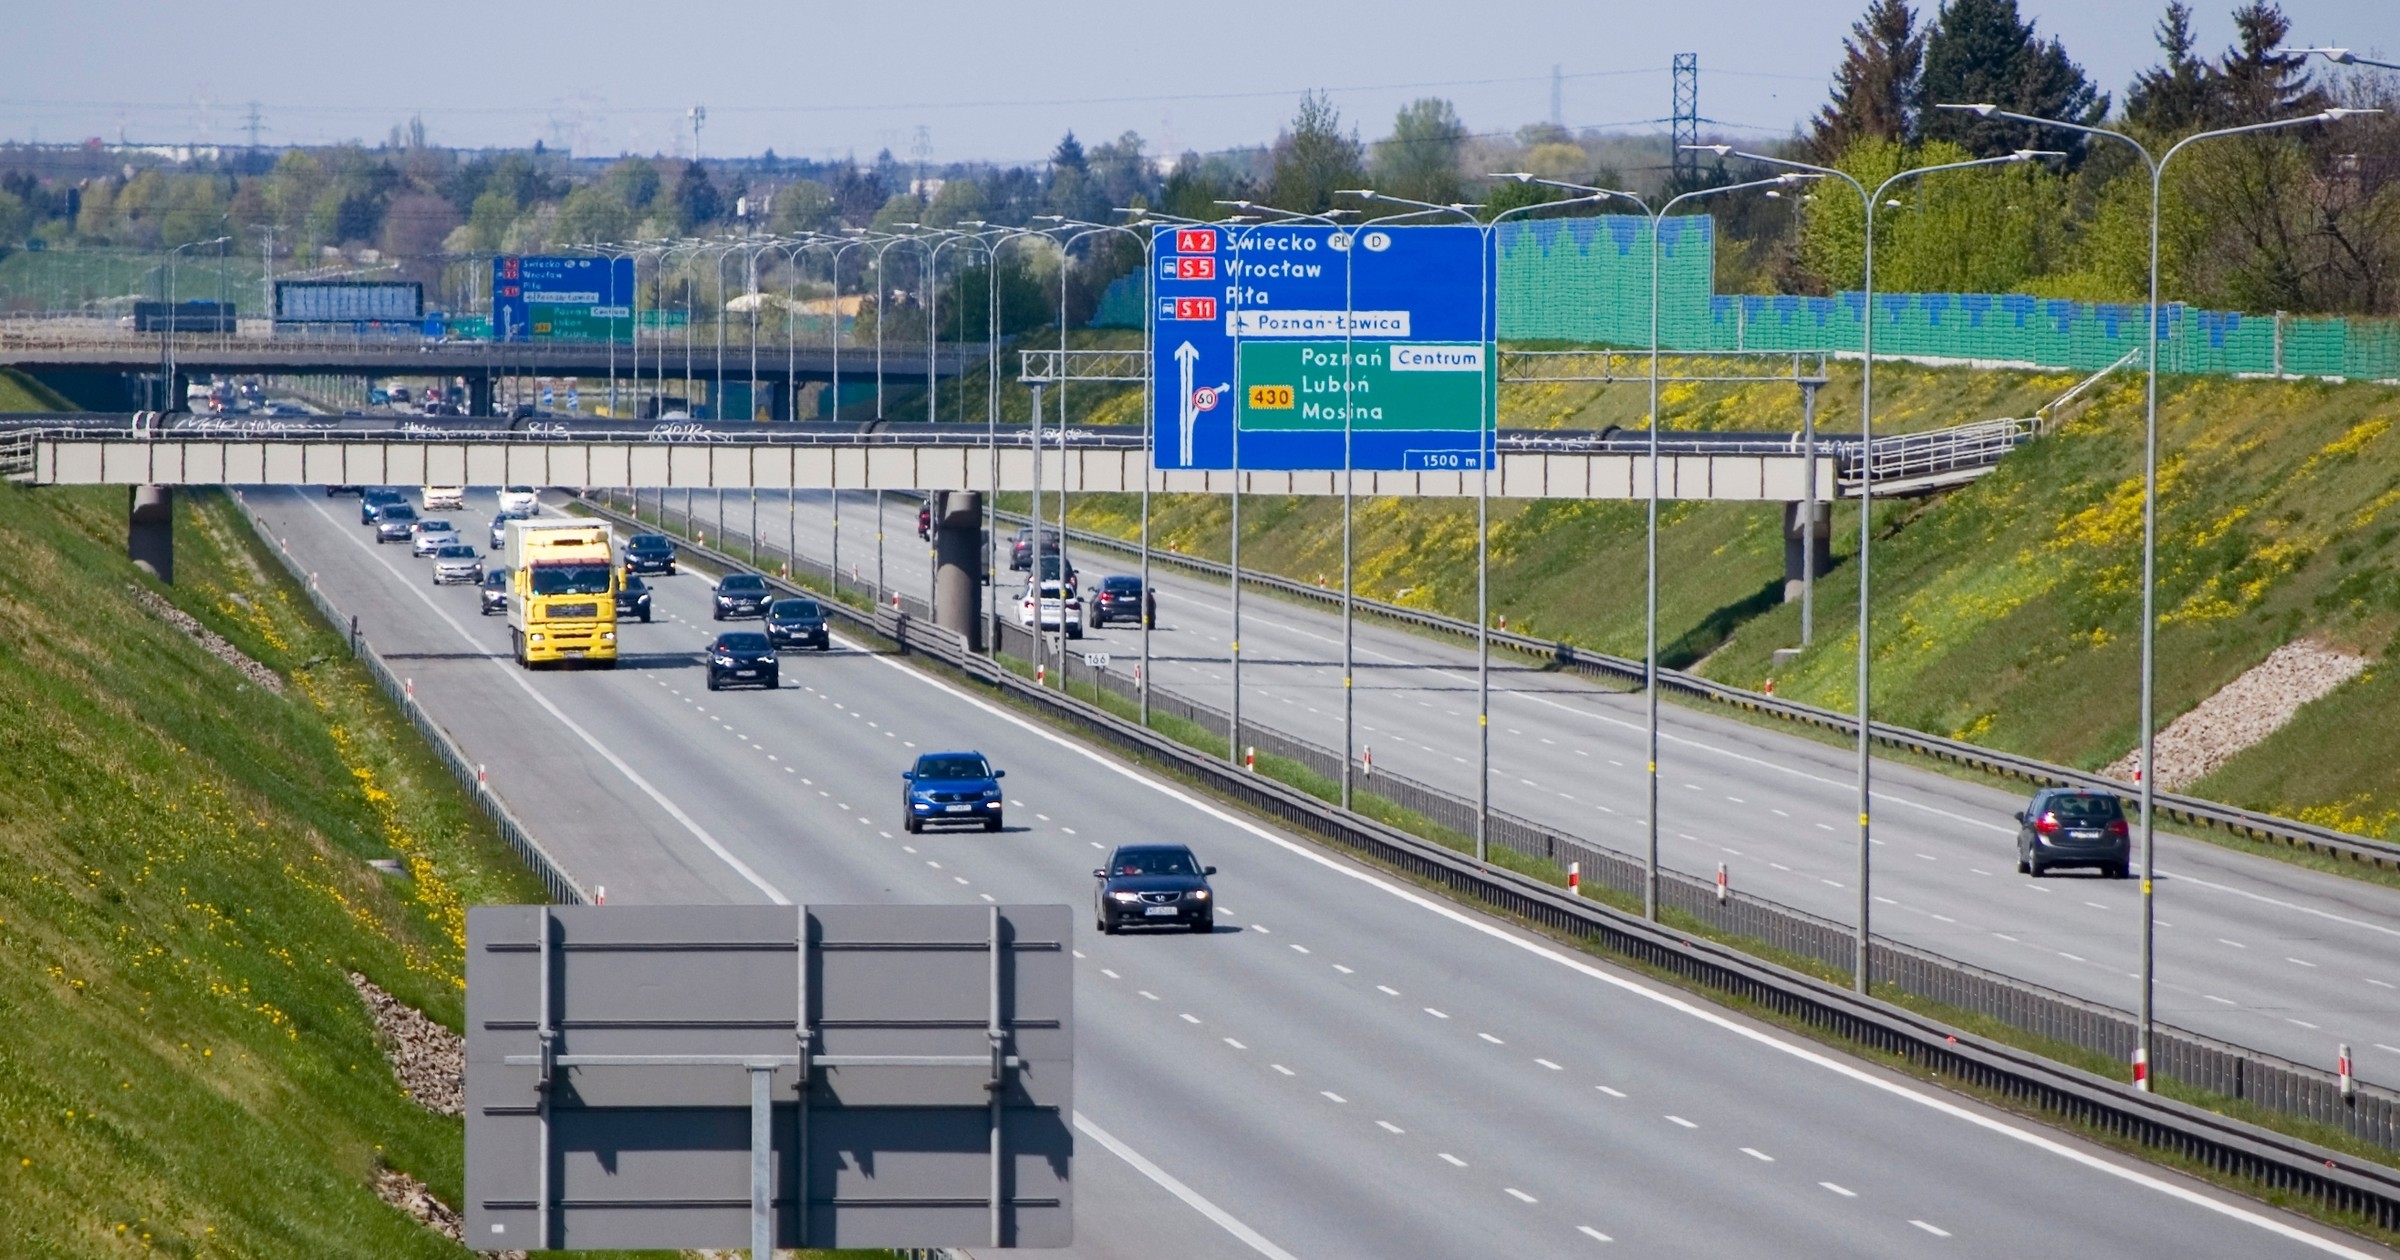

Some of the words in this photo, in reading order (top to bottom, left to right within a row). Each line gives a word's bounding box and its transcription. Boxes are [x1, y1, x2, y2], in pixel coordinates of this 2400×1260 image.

[1226, 226, 1317, 251] Świecko
[1372, 236, 1382, 247] D
[1225, 259, 1321, 277] Wrocław
[1226, 286, 1268, 304] Piła
[1259, 315, 1401, 330] Poznań-Ławica
[1302, 347, 1382, 366] Poznań
[1399, 350, 1477, 365] Centrum
[1303, 375, 1369, 393] Luboń
[1197, 393, 1214, 405] 60
[1254, 390, 1289, 405] 430
[1303, 402, 1383, 420] Mosina
[1423, 454, 1459, 467] 1500
[1465, 458, 1477, 467] m
[1088, 655, 1106, 664] 166
